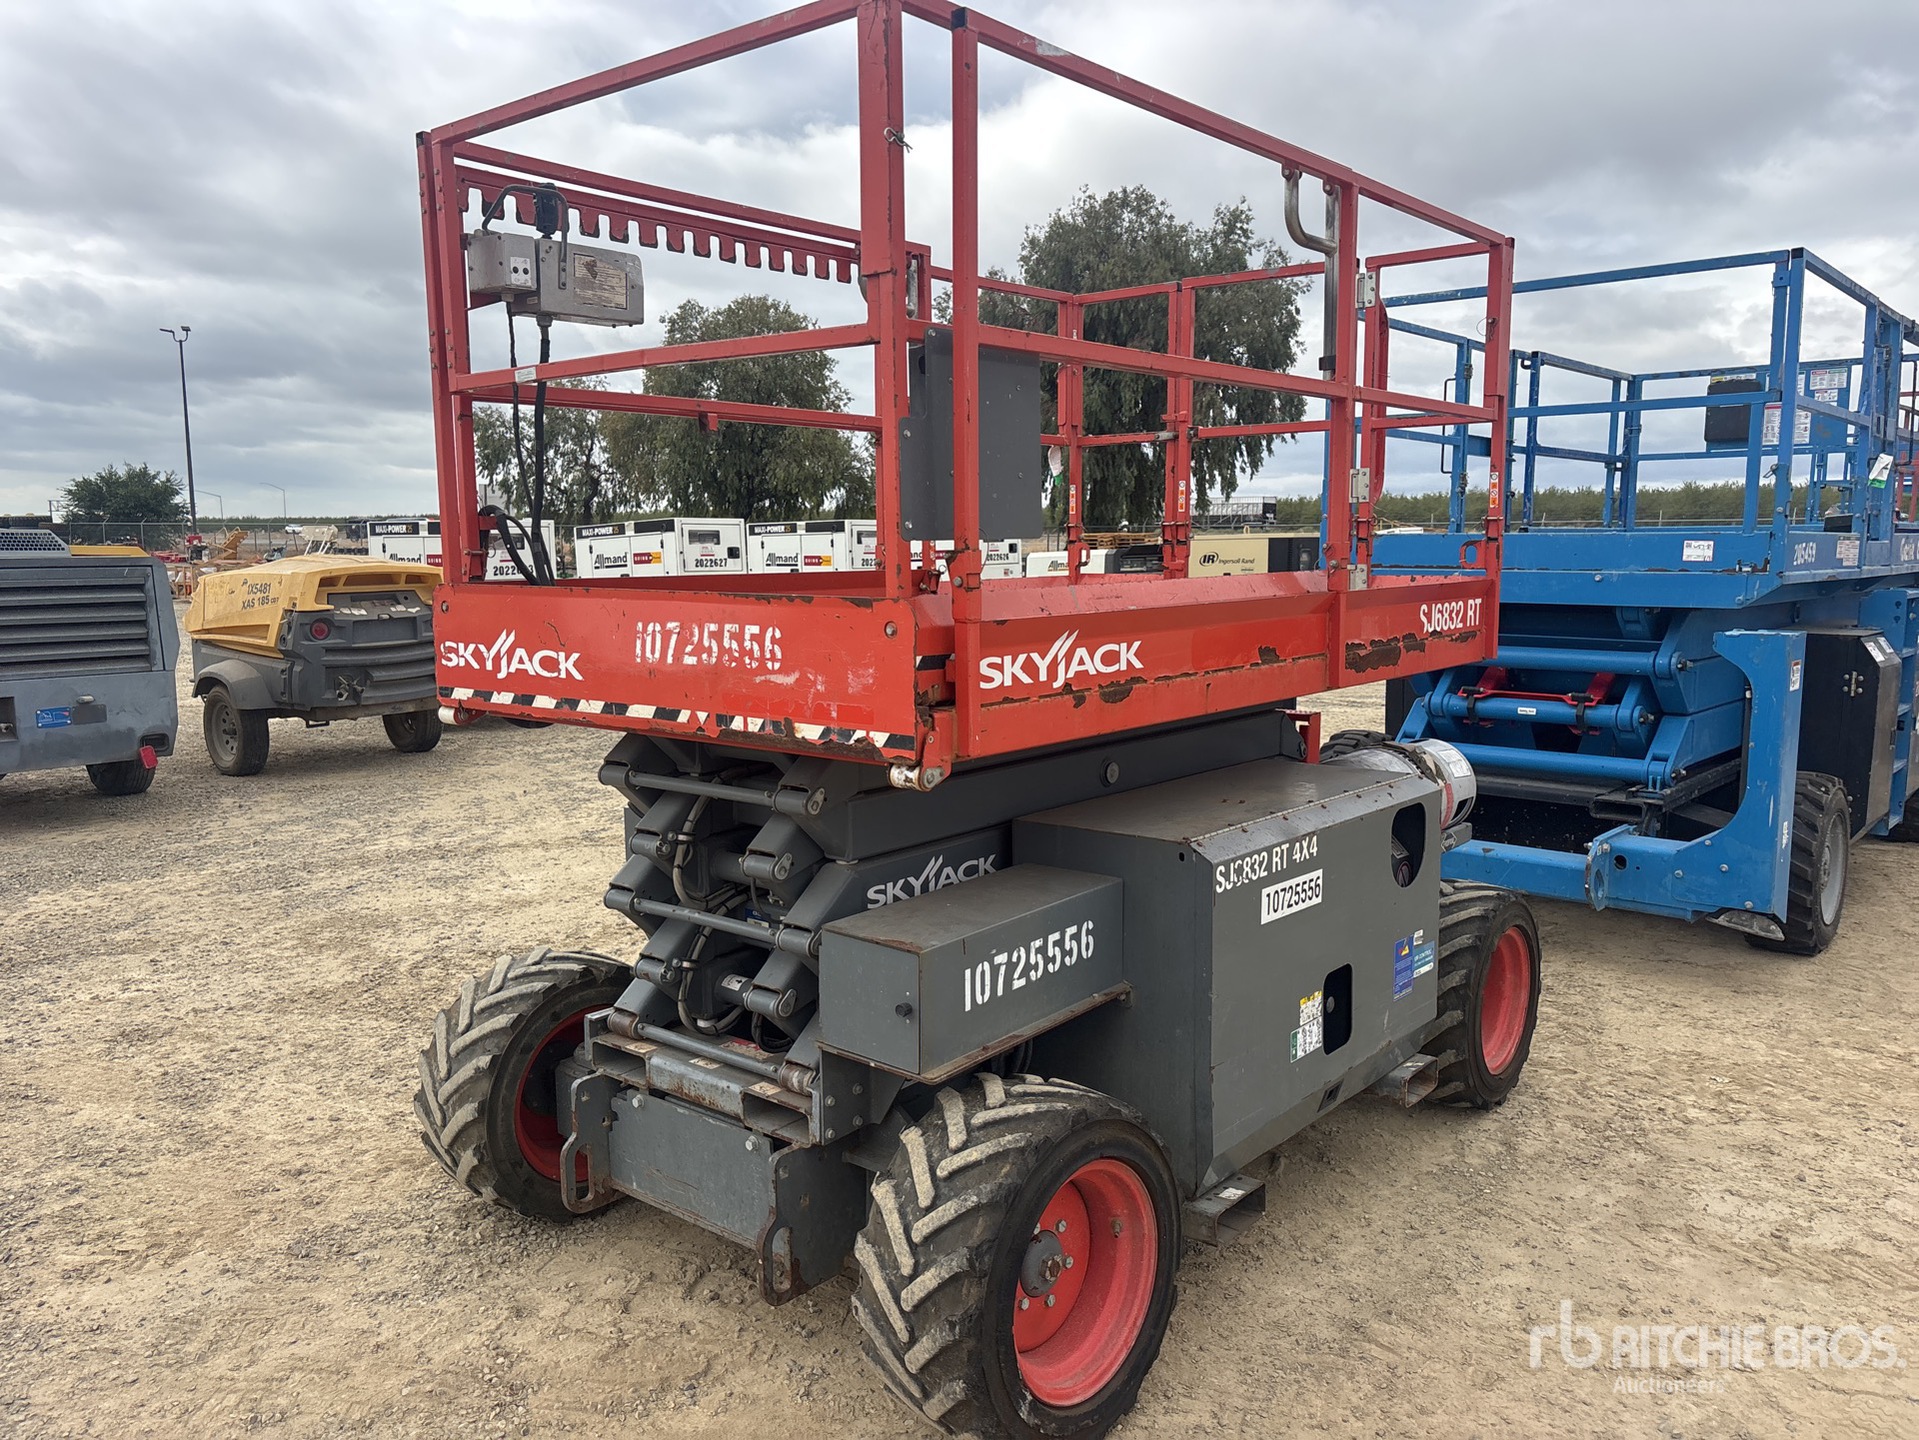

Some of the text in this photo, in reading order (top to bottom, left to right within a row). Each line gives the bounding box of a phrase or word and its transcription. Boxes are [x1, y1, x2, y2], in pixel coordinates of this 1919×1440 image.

[582, 527, 613, 537] MAXI-POWER
[594, 552, 628, 565] Allmand
[695, 558, 728, 568] 2022627
[766, 552, 799, 564] Allmand
[241, 598, 256, 610] XAS
[257, 596, 270, 606] 185
[1420, 598, 1482, 633] SJ6832 RT
[441, 629, 584, 681] SKYJACK
[635, 621, 783, 671] 10725556
[979, 629, 1144, 690] SKYJACK
[1272, 843, 1290, 873] RT
[1292, 835, 1318, 863] 4X4
[866, 854, 998, 909] SKYJACK
[1265, 875, 1321, 916] 10725556
[964, 920, 1095, 1012] 10725556
